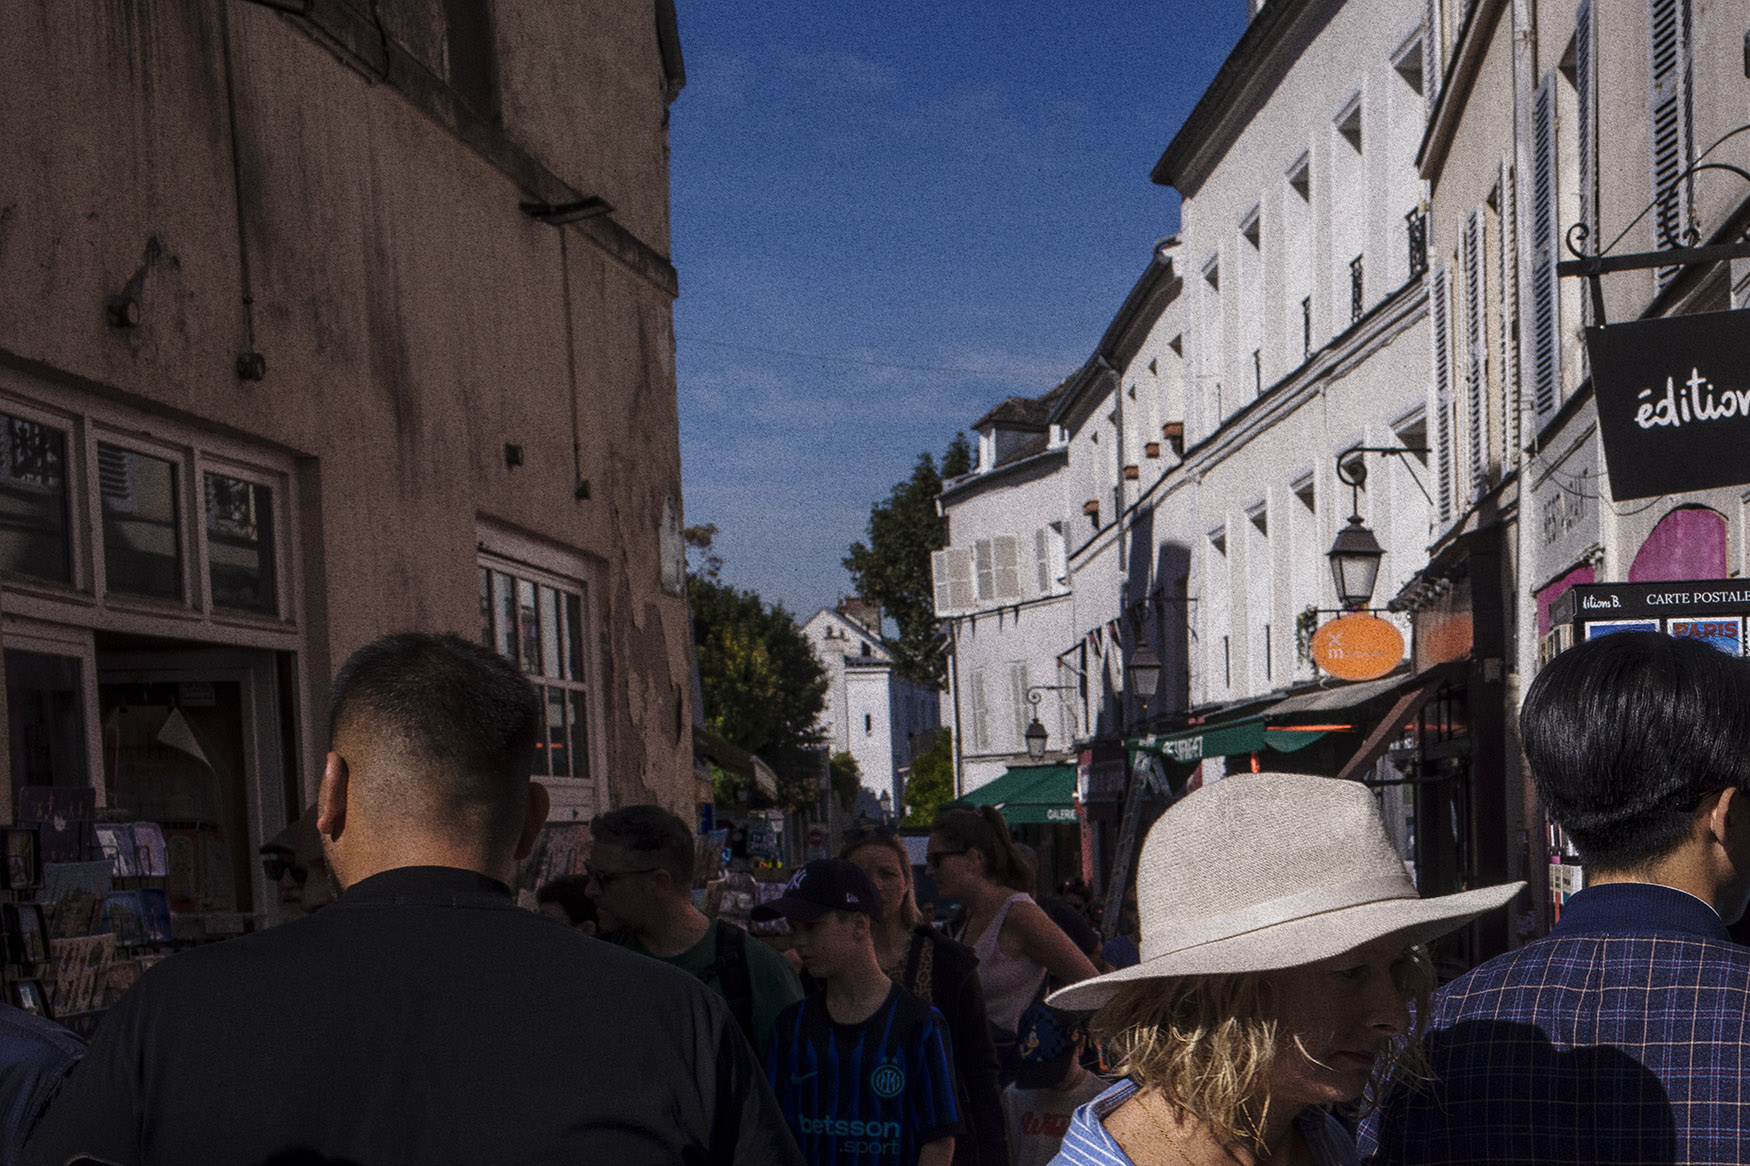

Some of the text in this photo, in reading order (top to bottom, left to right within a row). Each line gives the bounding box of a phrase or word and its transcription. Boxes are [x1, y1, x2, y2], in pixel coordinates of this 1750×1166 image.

[1646, 593, 1689, 606] CARTE
[1673, 622, 1738, 638] PARIS
[798, 1112, 900, 1138] betsson
